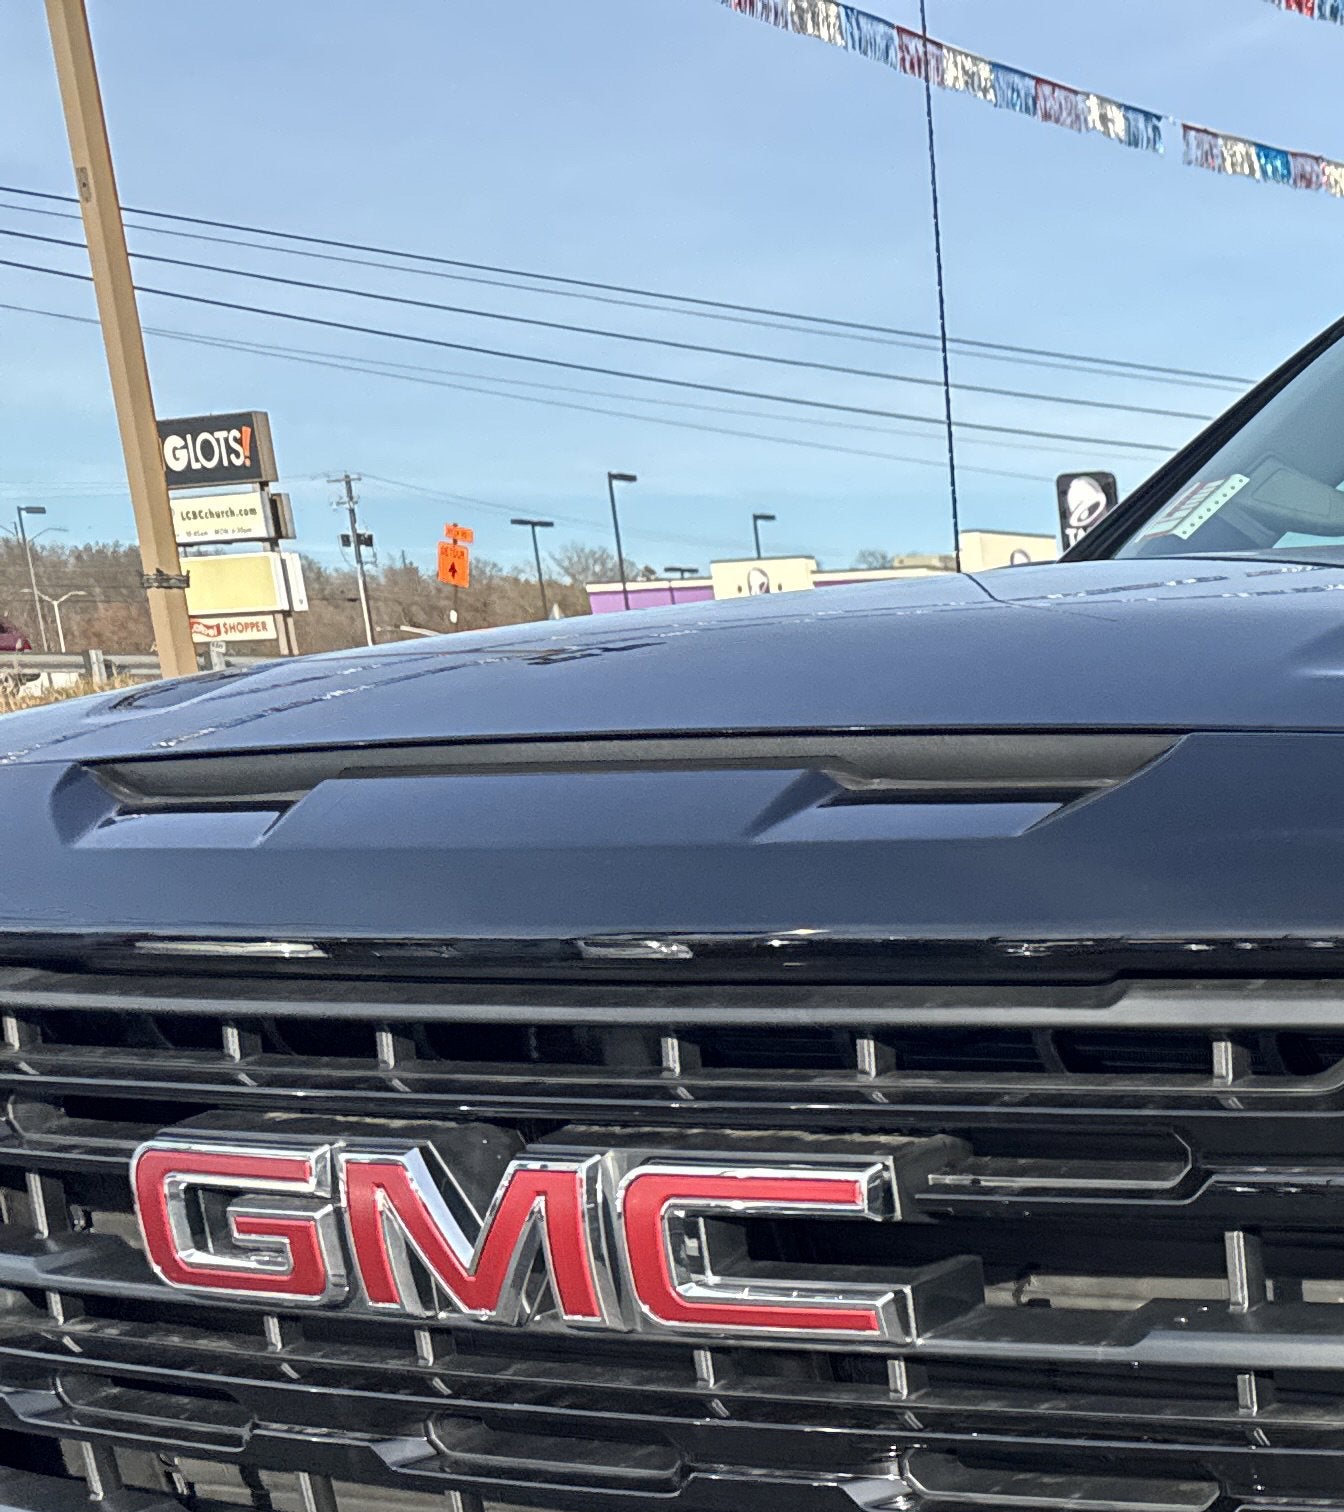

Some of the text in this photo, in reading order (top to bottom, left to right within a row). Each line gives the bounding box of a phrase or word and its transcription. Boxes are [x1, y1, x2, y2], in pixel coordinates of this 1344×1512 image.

[160, 426, 251, 471] GLOTS!
[180, 507, 258, 521] LCBCchurch.com
[131, 1139, 913, 1344] GMC
